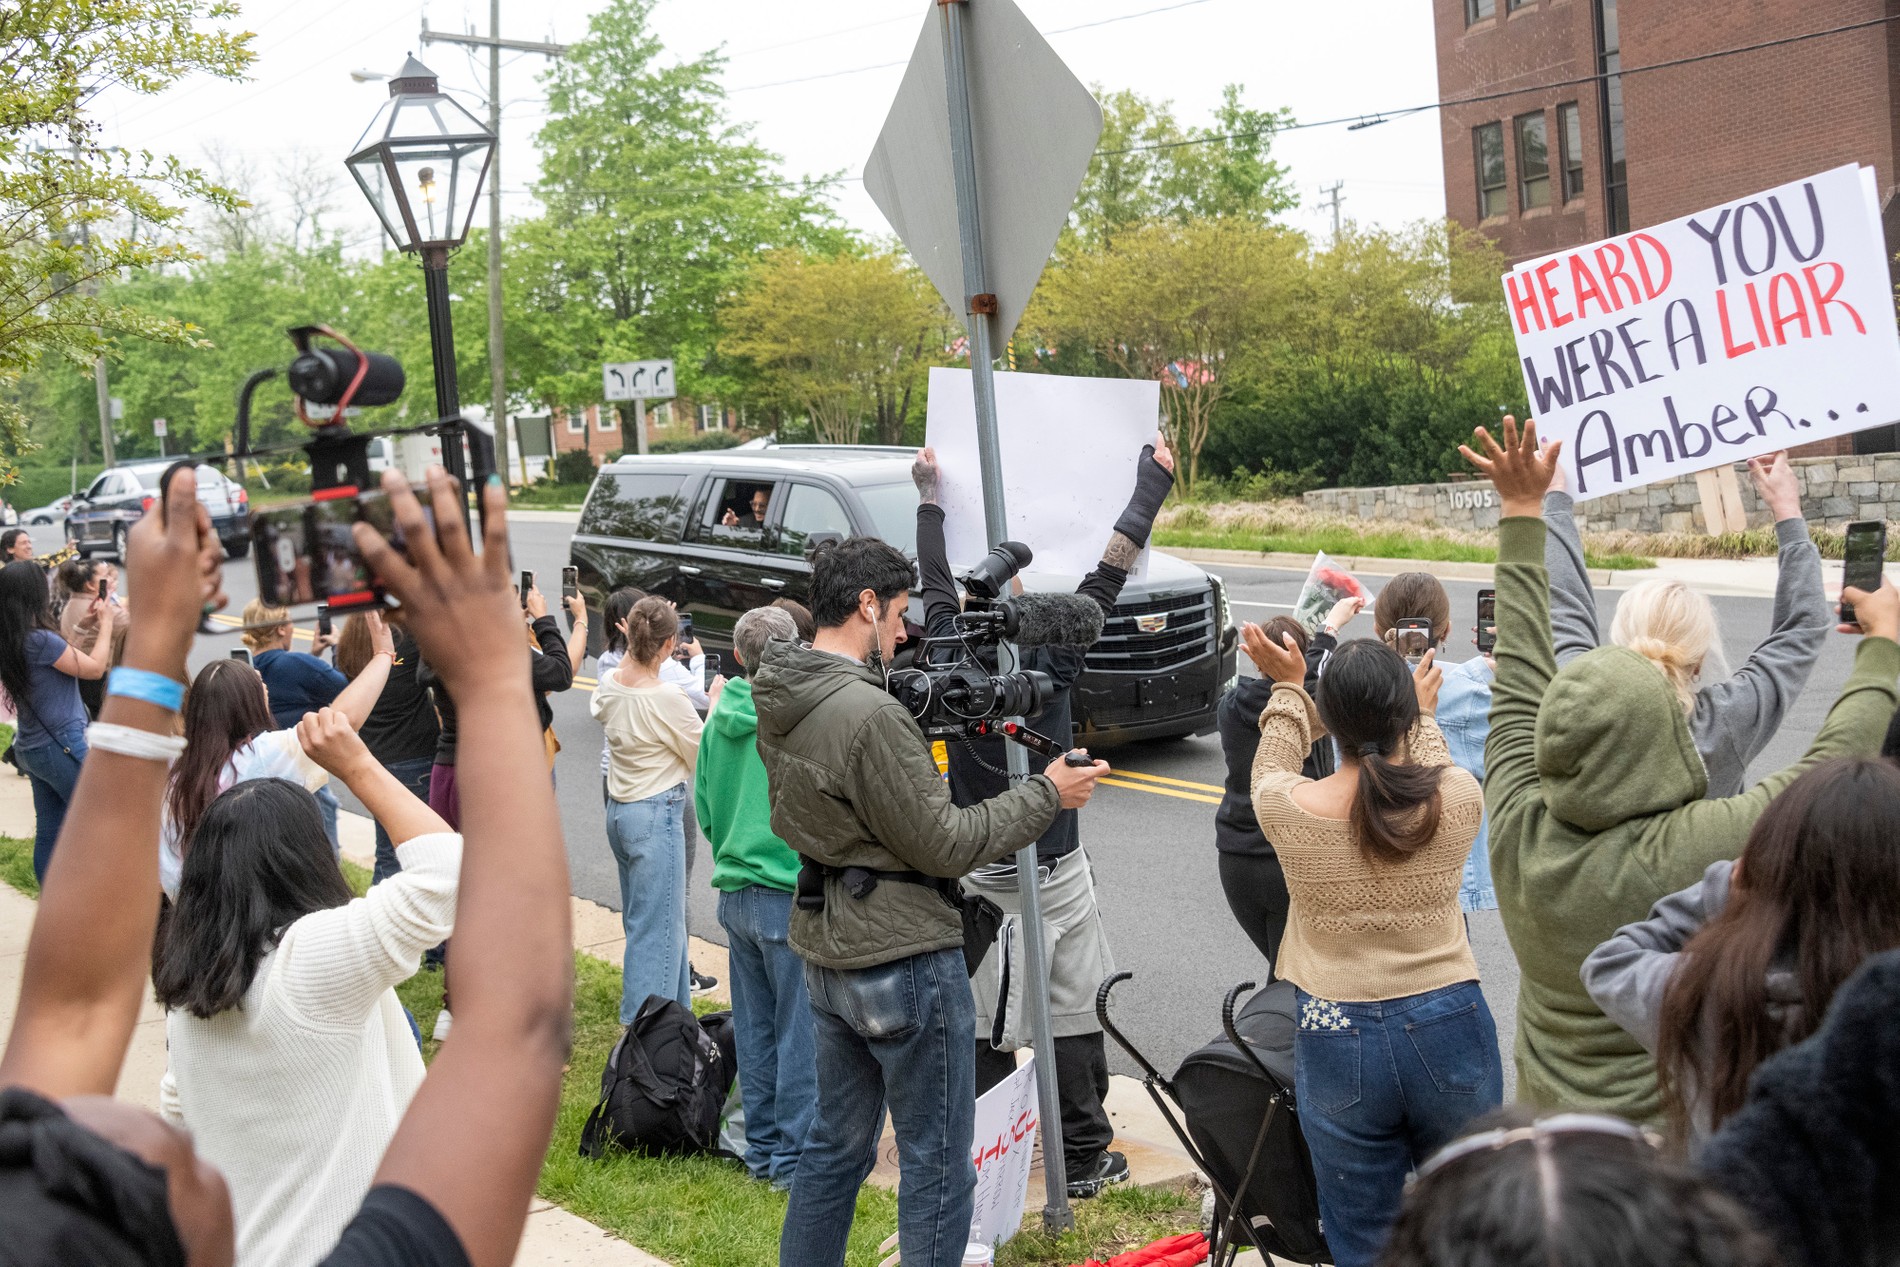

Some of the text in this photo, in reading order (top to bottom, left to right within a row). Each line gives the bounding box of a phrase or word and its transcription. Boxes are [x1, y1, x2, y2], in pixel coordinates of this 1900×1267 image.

[1507, 182, 1825, 335] HEARD YOU
[1523, 261, 1867, 415] WERE A LIAR
[1449, 488, 1493, 510] 10505
